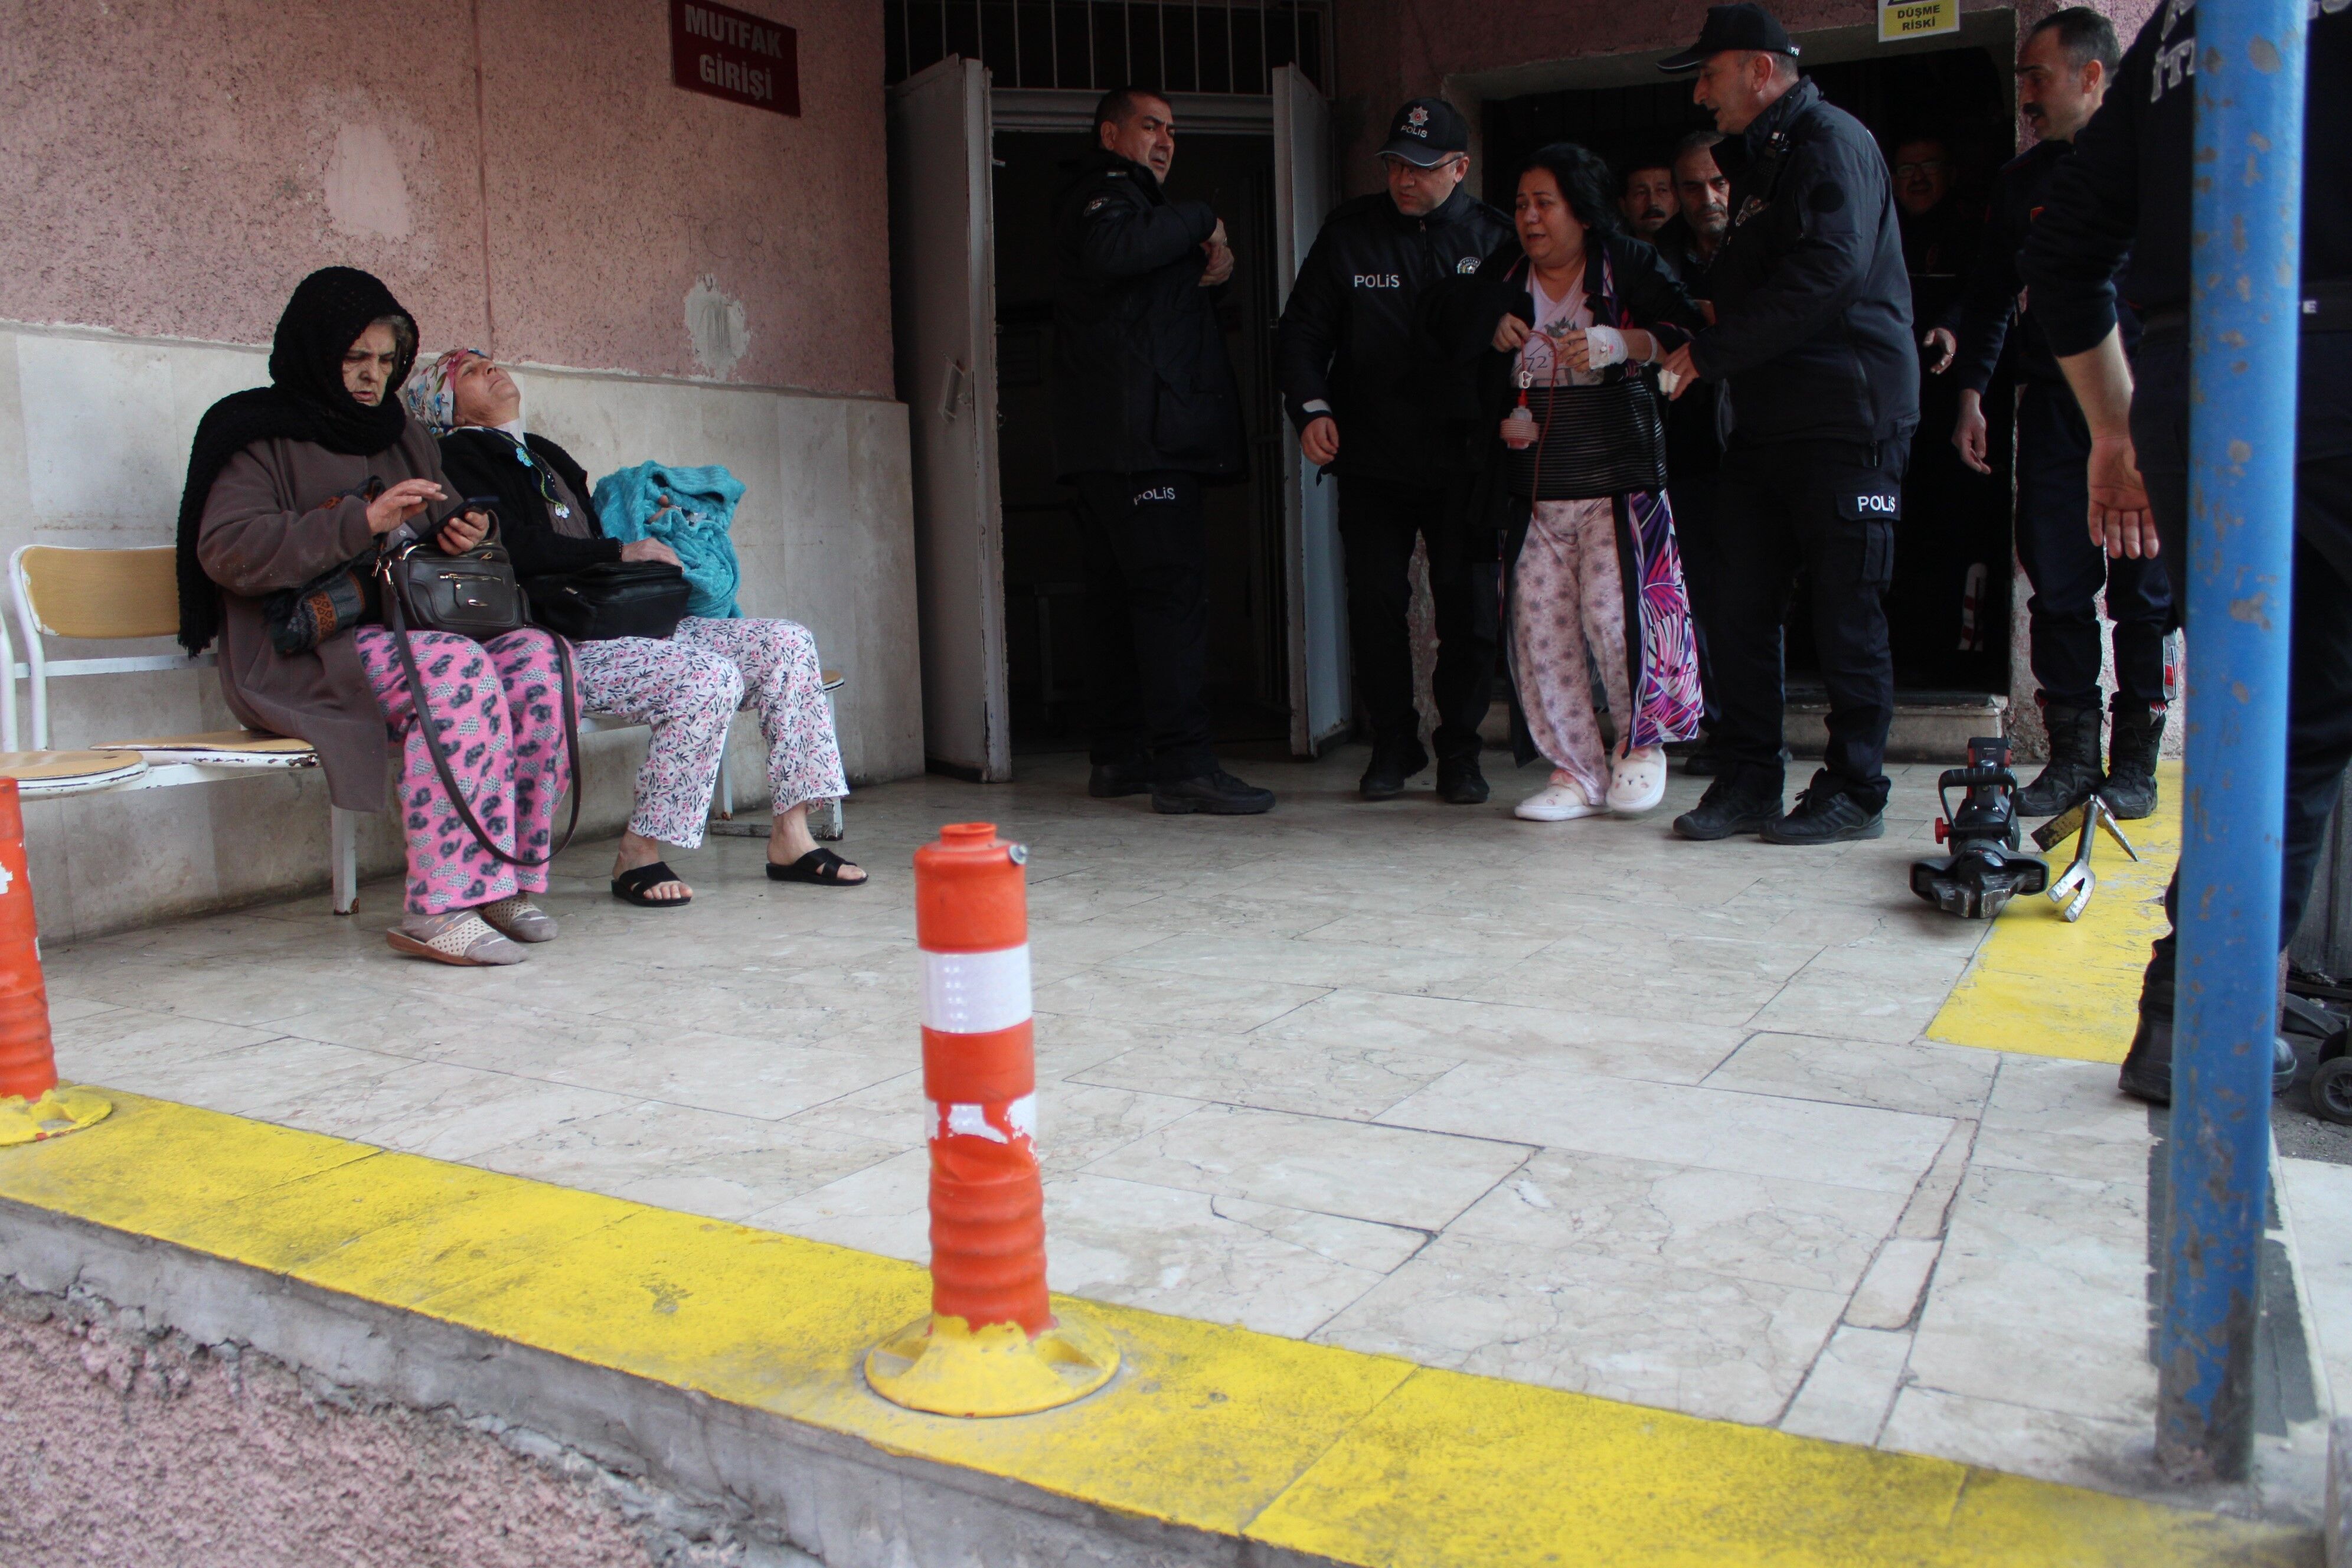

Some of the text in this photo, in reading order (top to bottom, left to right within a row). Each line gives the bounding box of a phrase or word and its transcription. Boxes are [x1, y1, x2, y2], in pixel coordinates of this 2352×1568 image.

[1897, 5, 1941, 19] DÜŞME
[1902, 17, 1936, 31] RİSKİ
[685, 4, 783, 58] MUTFAK
[700, 53, 772, 100] GİRİŞİ
